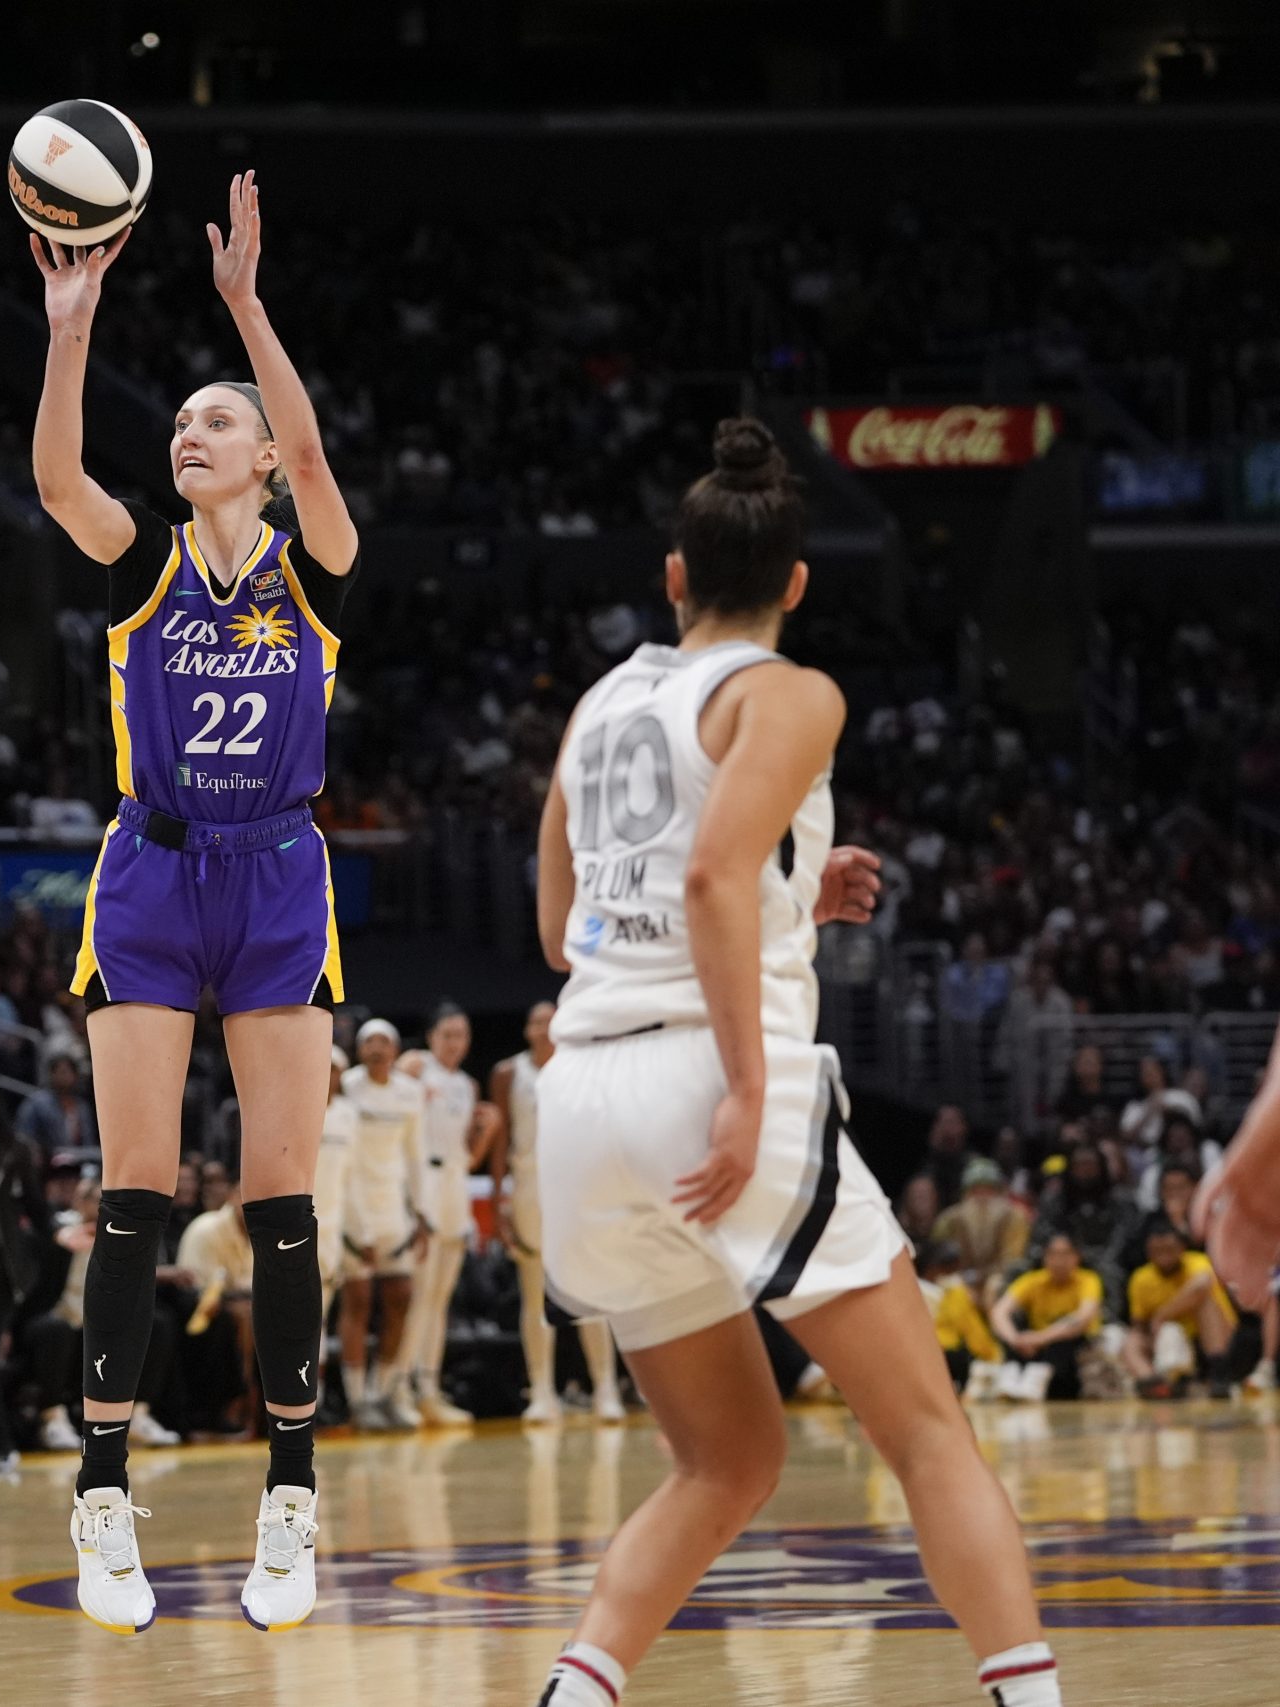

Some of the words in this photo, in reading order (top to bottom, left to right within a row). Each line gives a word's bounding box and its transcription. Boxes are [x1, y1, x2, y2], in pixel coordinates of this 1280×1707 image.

[254, 574, 278, 586] UCLA
[254, 587, 286, 602] Health
[161, 609, 220, 645] LOS
[163, 640, 299, 678] ANGELES
[184, 691, 267, 755] 22
[195, 772, 268, 794] EquiTrust
[575, 714, 677, 852] 10
[583, 858, 648, 901] PLUM
